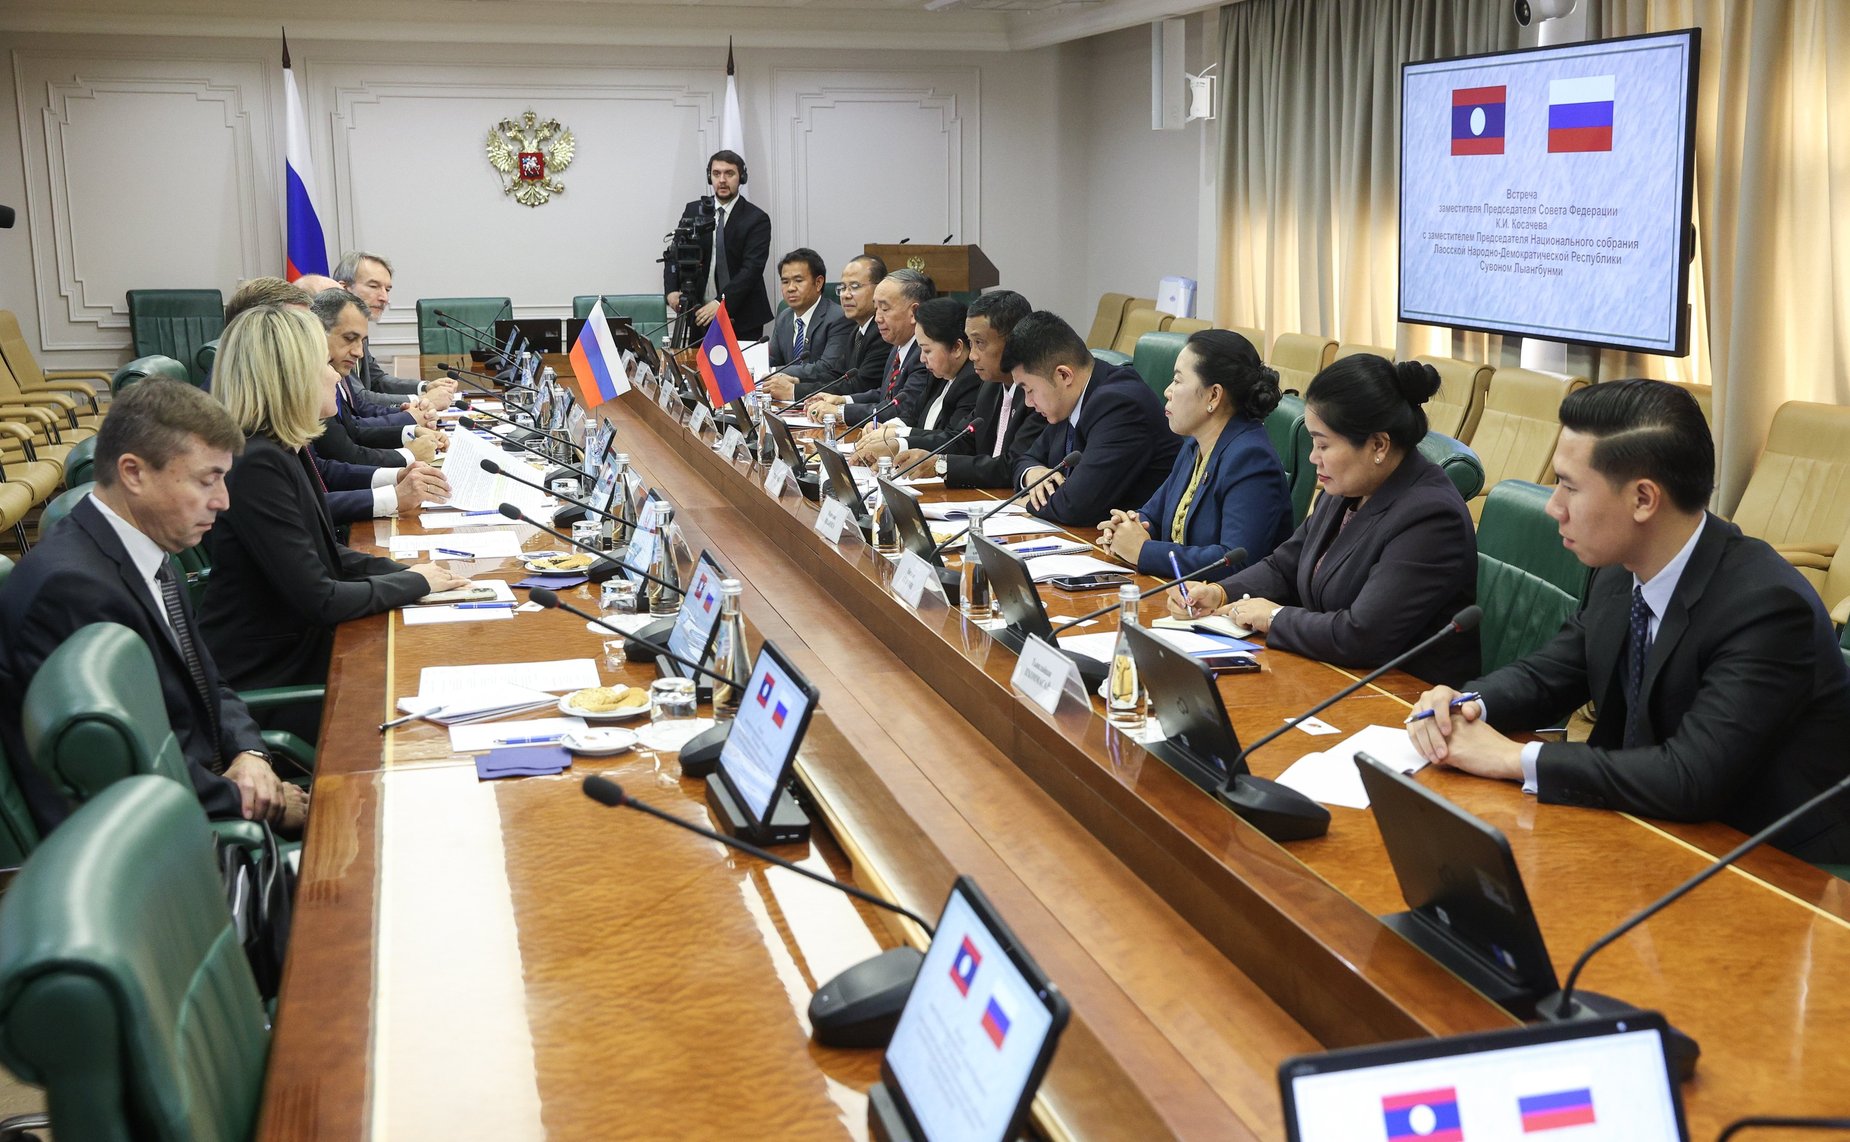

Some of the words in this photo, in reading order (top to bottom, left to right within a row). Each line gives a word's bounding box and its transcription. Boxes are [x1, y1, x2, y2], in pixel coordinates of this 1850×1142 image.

[1506, 188, 1537, 201] Встреча
[1439, 205, 1482, 213] заместителя
[1484, 204, 1537, 216] Председателя
[1539, 204, 1567, 216] Совета
[1570, 205, 1618, 217] Федерации
[1496, 219, 1509, 229] К.И.
[1512, 219, 1547, 230] Косачева
[1428, 232, 1475, 241] заместителем
[1476, 232, 1529, 245] Председателя
[1531, 235, 1594, 247] Национального
[1596, 237, 1638, 251] собрания
[1434, 244, 1466, 255] Лаосской
[1467, 247, 1569, 261] Народно-Демократической
[1571, 251, 1622, 265] Республики
[1480, 260, 1512, 274] Сувоном
[1514, 262, 1563, 277] Лыангбунми
